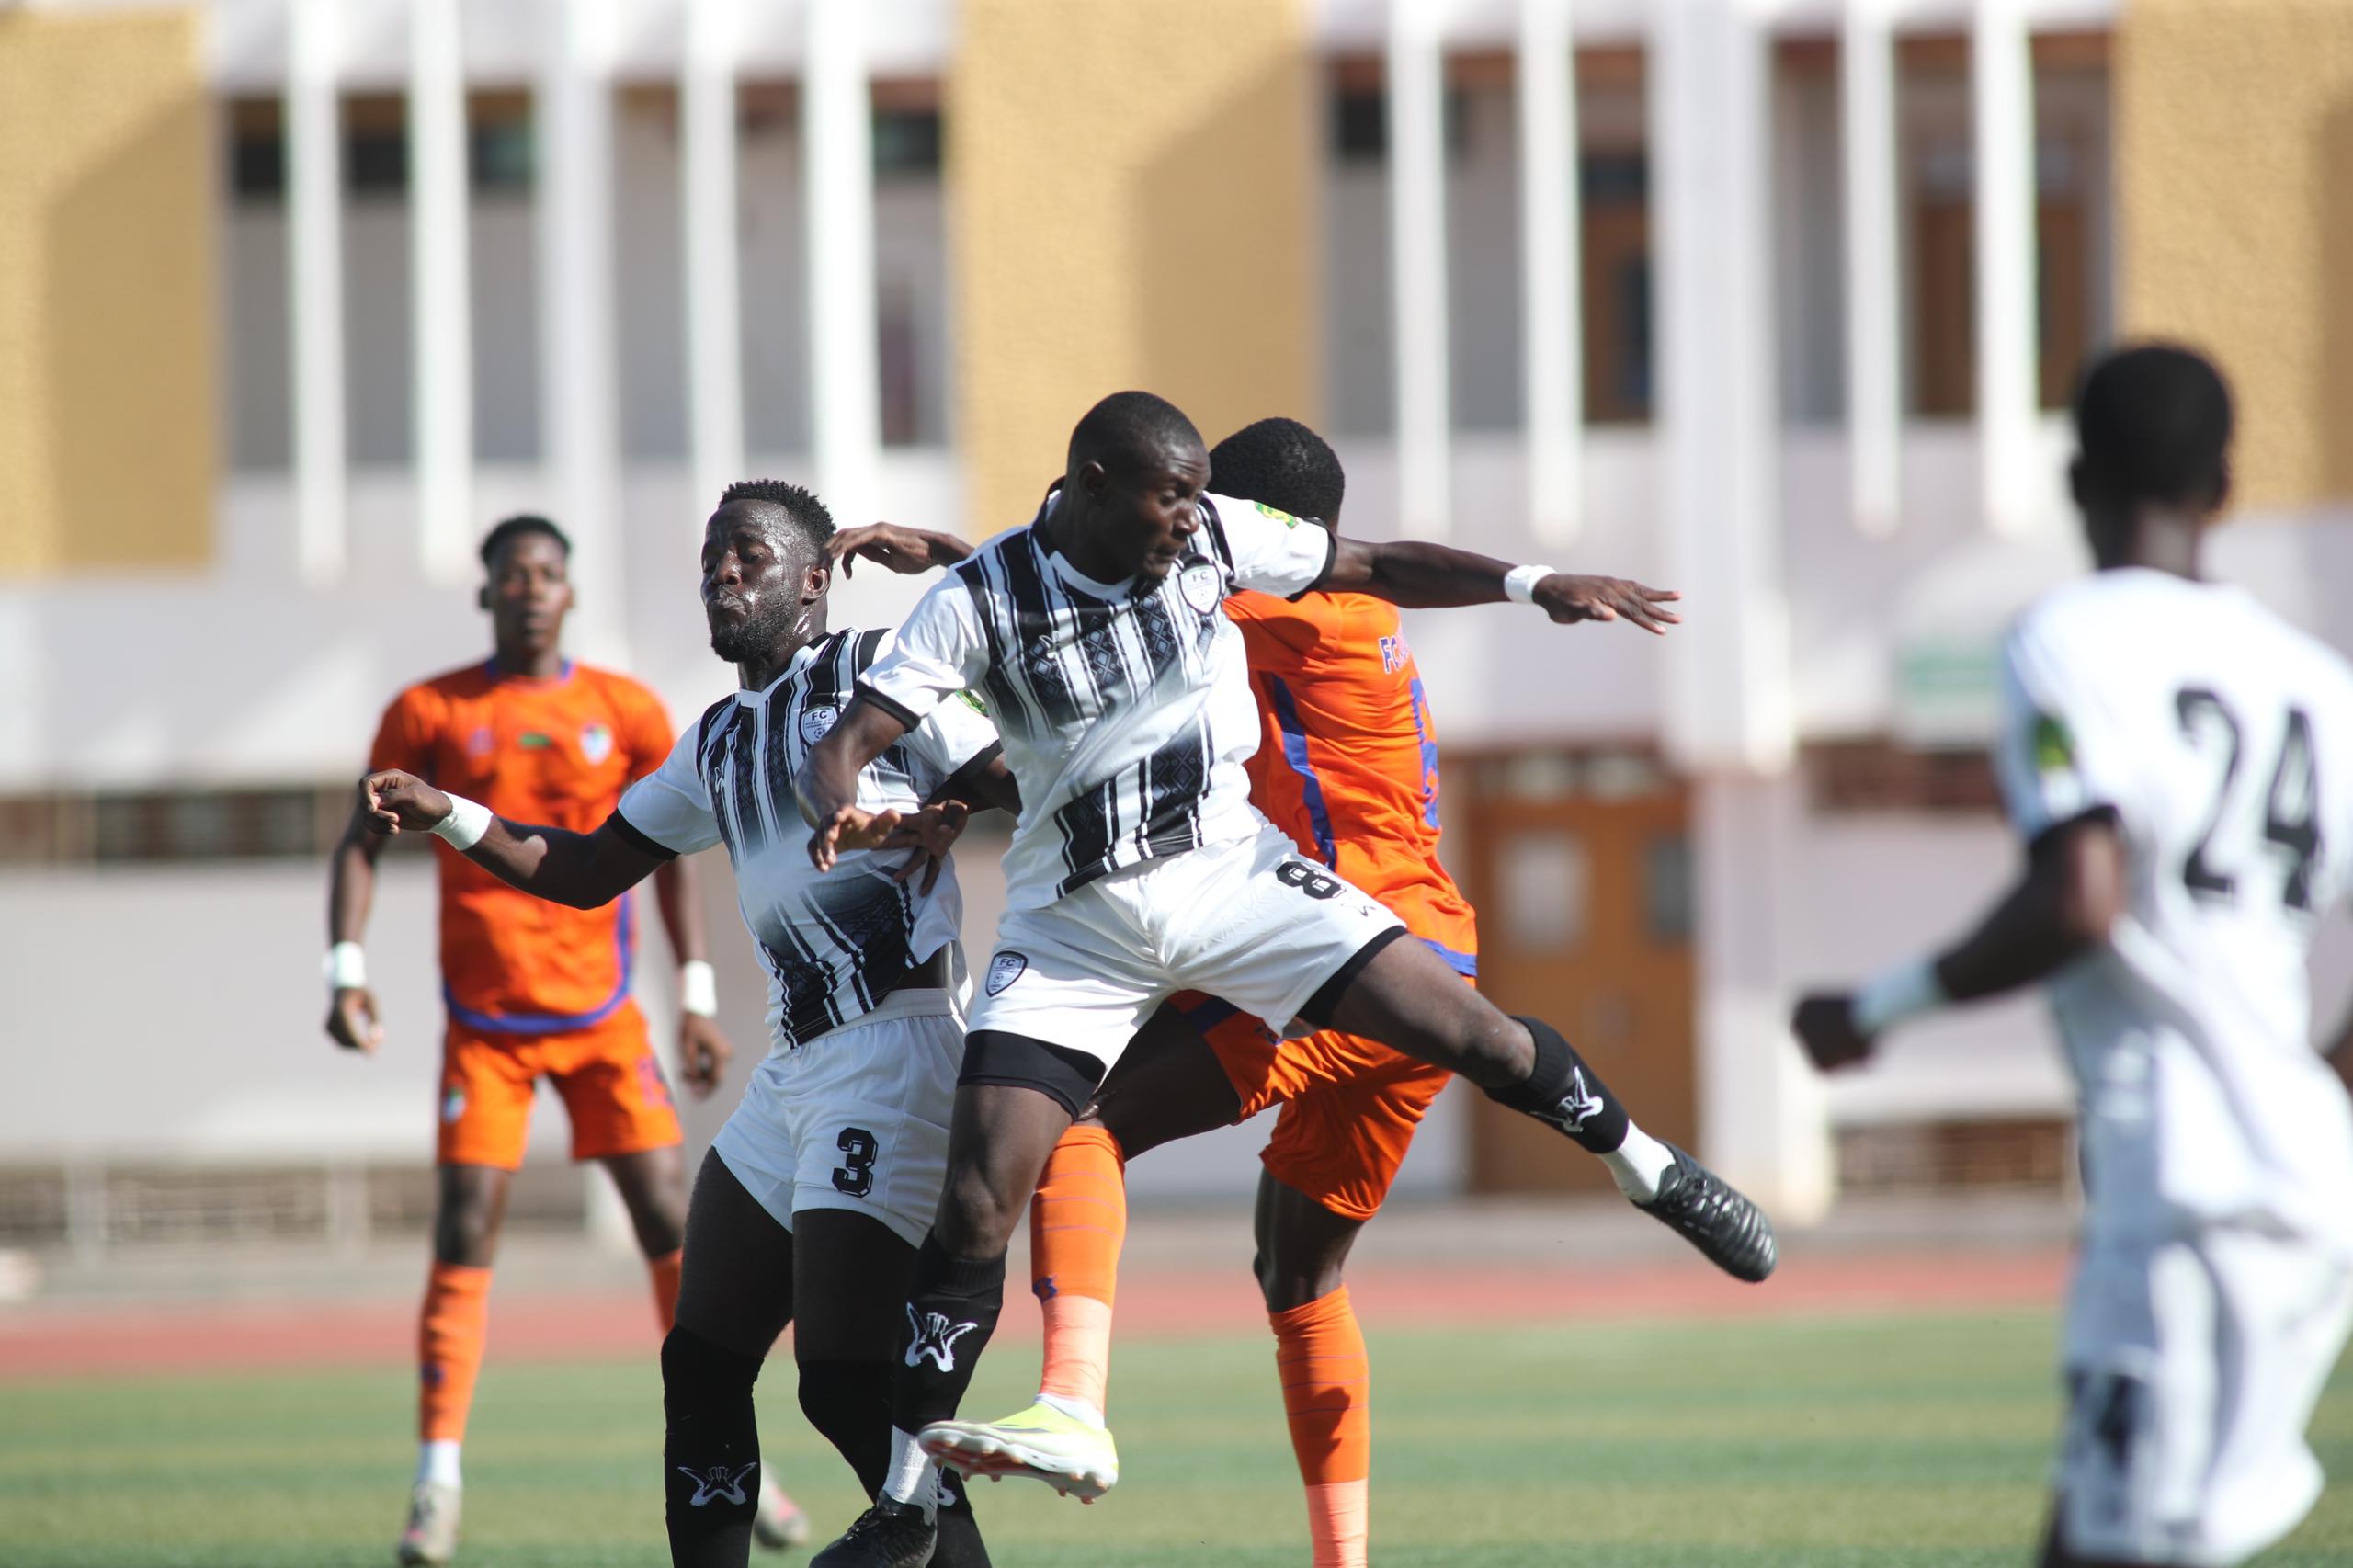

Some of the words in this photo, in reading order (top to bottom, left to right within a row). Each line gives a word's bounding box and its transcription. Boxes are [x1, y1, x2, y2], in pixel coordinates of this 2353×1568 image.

[811, 710, 828, 721] FC
[2175, 688, 2324, 911] 24
[1275, 860, 1347, 900] 8
[999, 958, 1017, 967] FC
[832, 1127, 878, 1198] 3
